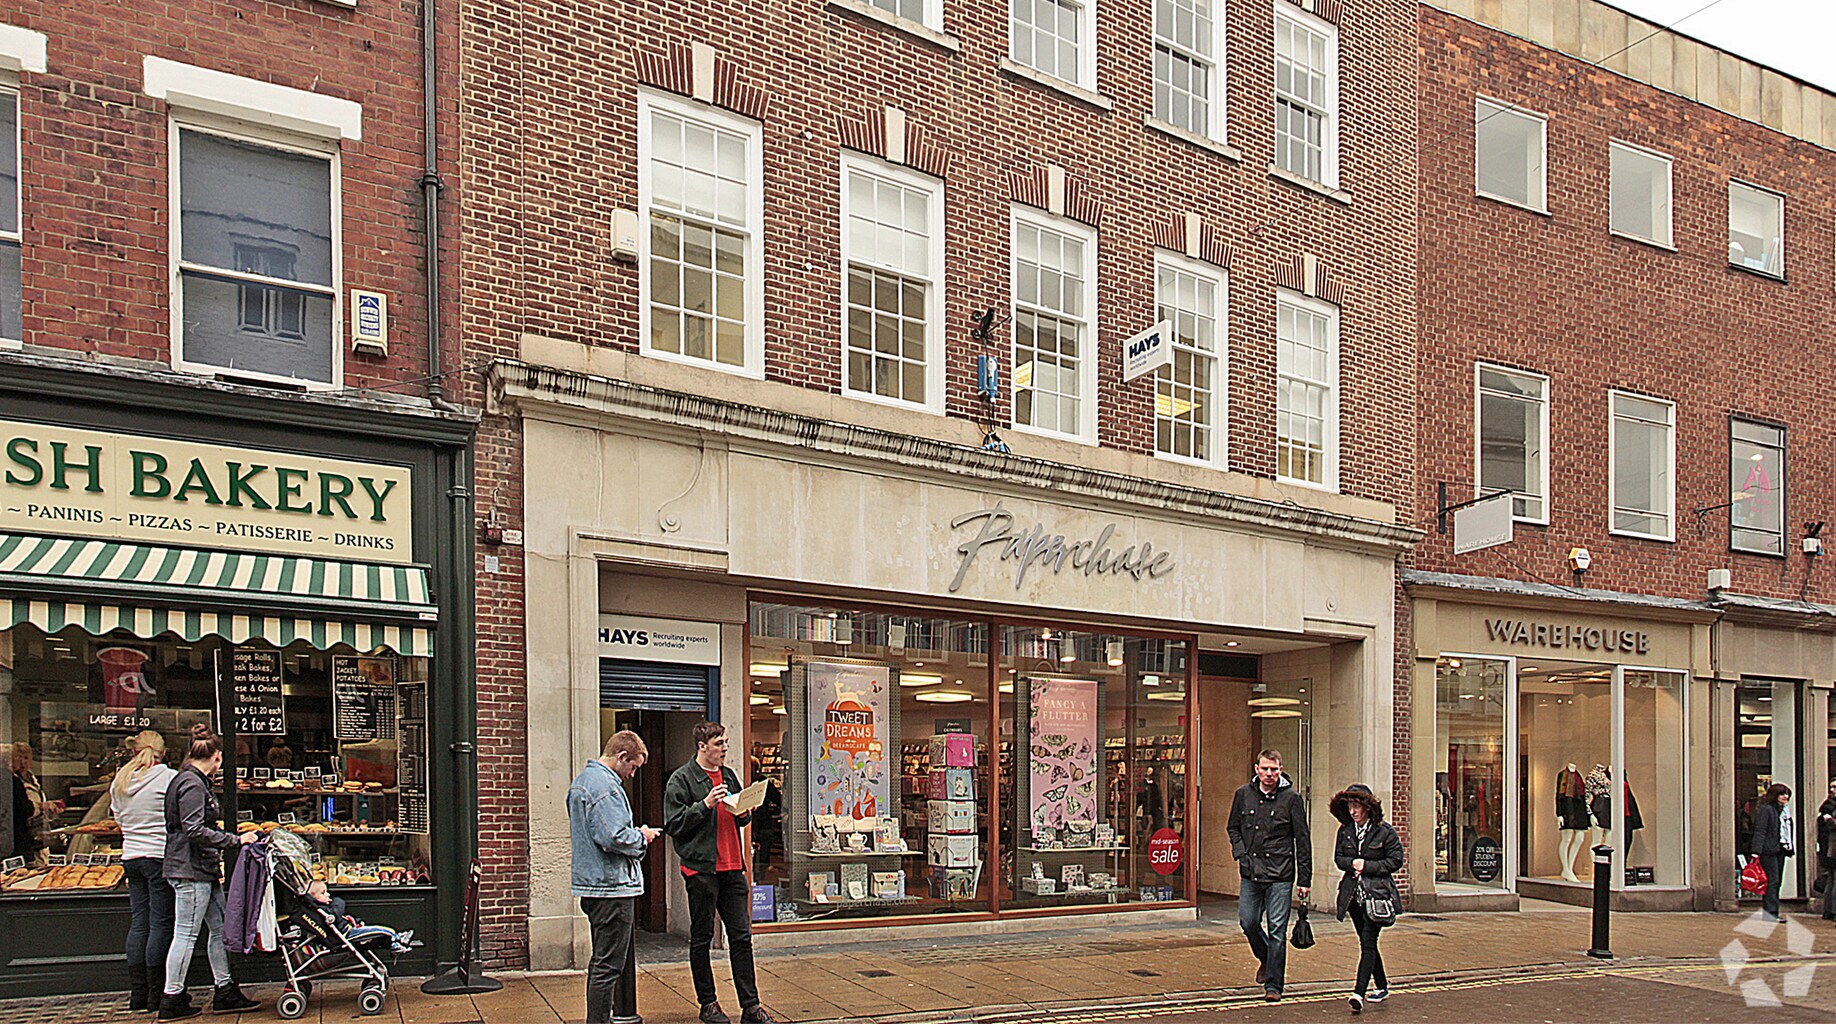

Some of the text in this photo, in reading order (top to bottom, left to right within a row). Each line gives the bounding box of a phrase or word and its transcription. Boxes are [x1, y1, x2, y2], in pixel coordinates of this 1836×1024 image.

[1129, 332, 1160, 359] HAYS
[5, 437, 397, 522] SH BAKERY
[27, 504, 395, 551] PANINIS PIZZAS PATISSERIE DRINKS
[948, 500, 1177, 592] Paperchase
[1456, 533, 1507, 552] WAREHOUSE
[598, 627, 709, 646] HAYS Recruiting experts
[1484, 618, 1651, 655] WAREHOUSE
[653, 641, 686, 650] worldwide
[248, 674, 270, 682] Bakes
[336, 675, 366, 683] POTATOES
[257, 684, 279, 693] Onion
[239, 694, 262, 703] Bakes
[1044, 699, 1087, 709] FANCY A
[268, 706, 282, 715] each
[1042, 711, 1088, 721] FLUTTER
[90, 714, 150, 727] LARGE £1.20
[829, 711, 869, 724] TWEET
[241, 717, 248, 731] 2
[251, 717, 266, 732] for
[268, 717, 283, 731] £2
[826, 724, 871, 738] DREAMS
[1151, 845, 1179, 863] sale
[753, 892, 767, 901] 10%
